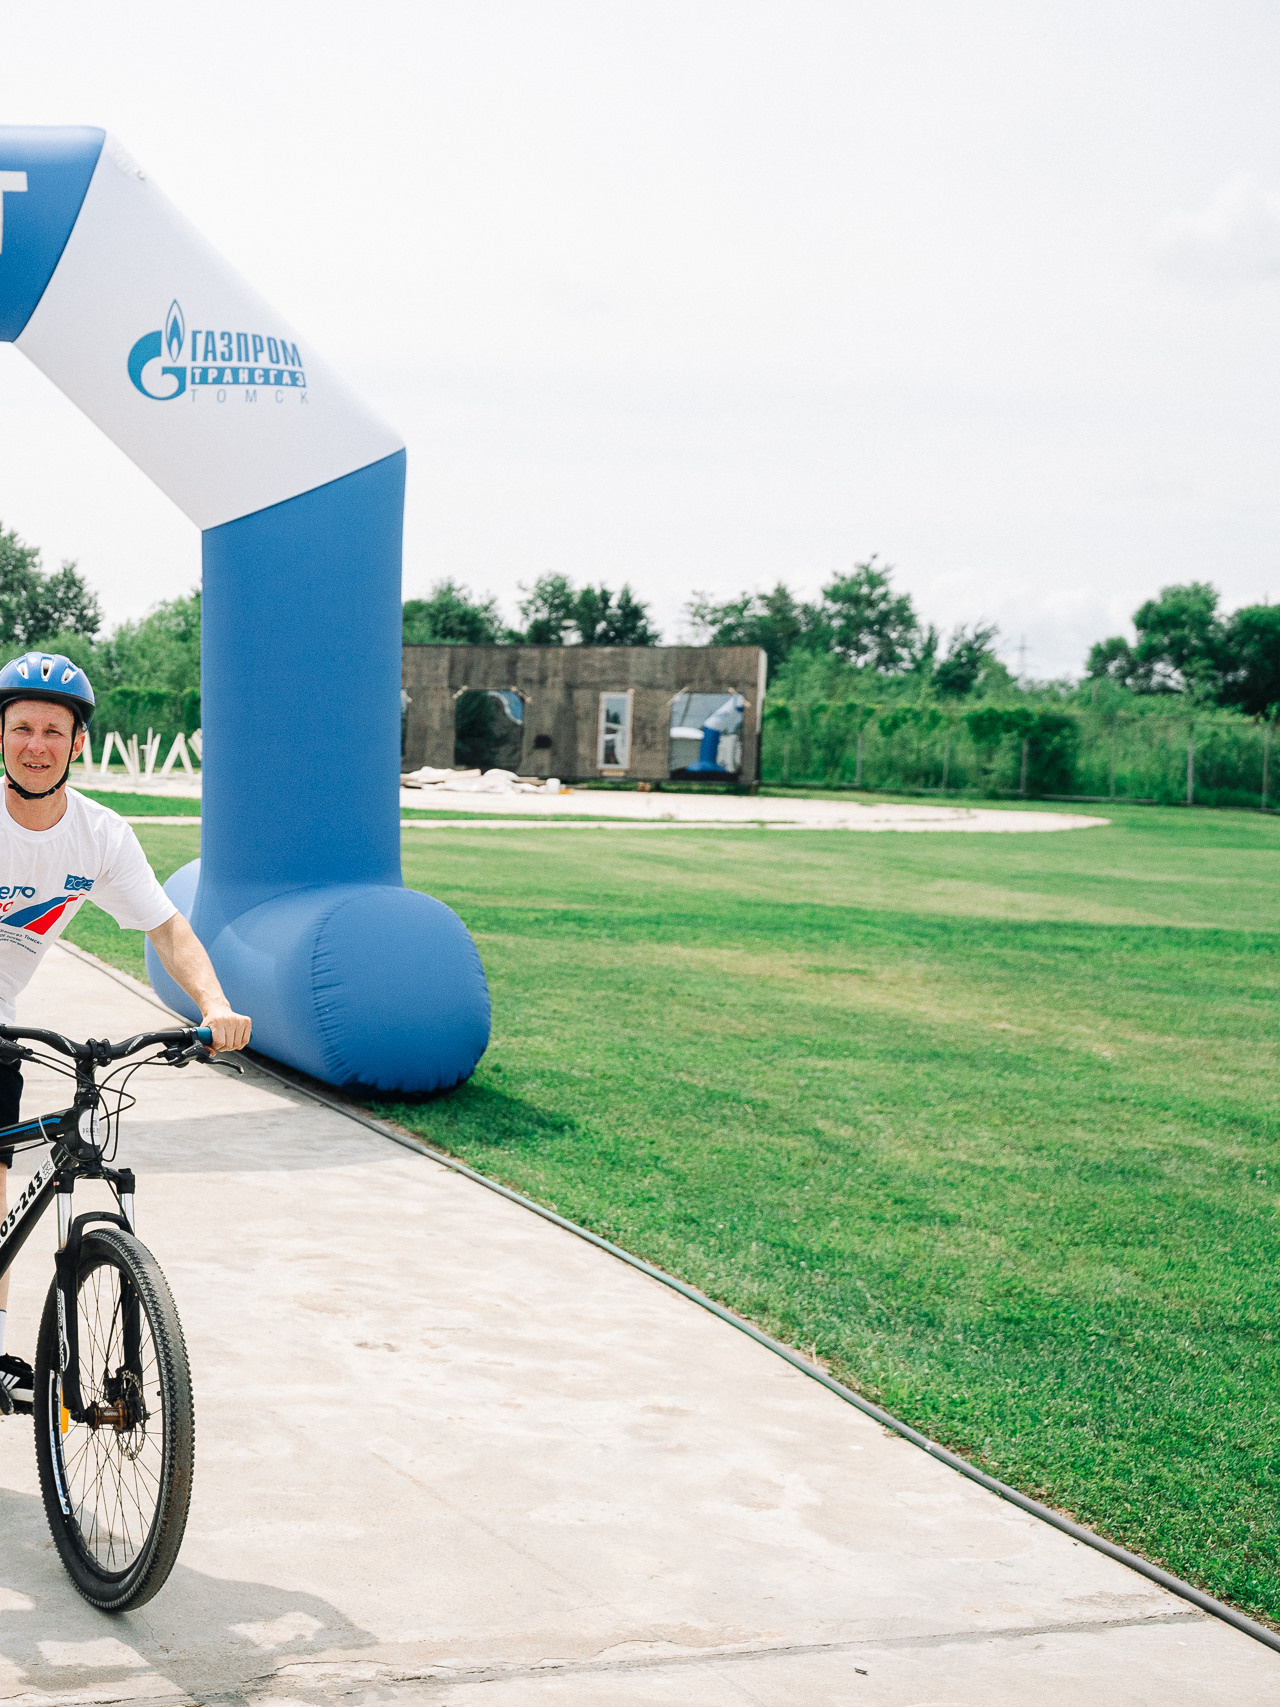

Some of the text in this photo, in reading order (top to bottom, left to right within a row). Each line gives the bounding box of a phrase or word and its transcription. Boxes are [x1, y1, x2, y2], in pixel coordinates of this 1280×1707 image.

[191, 330, 303, 367] ГАЗПРОМ
[191, 367, 306, 387] ТРАНСГАЗ
[191, 388, 309, 404] ТОМСК
